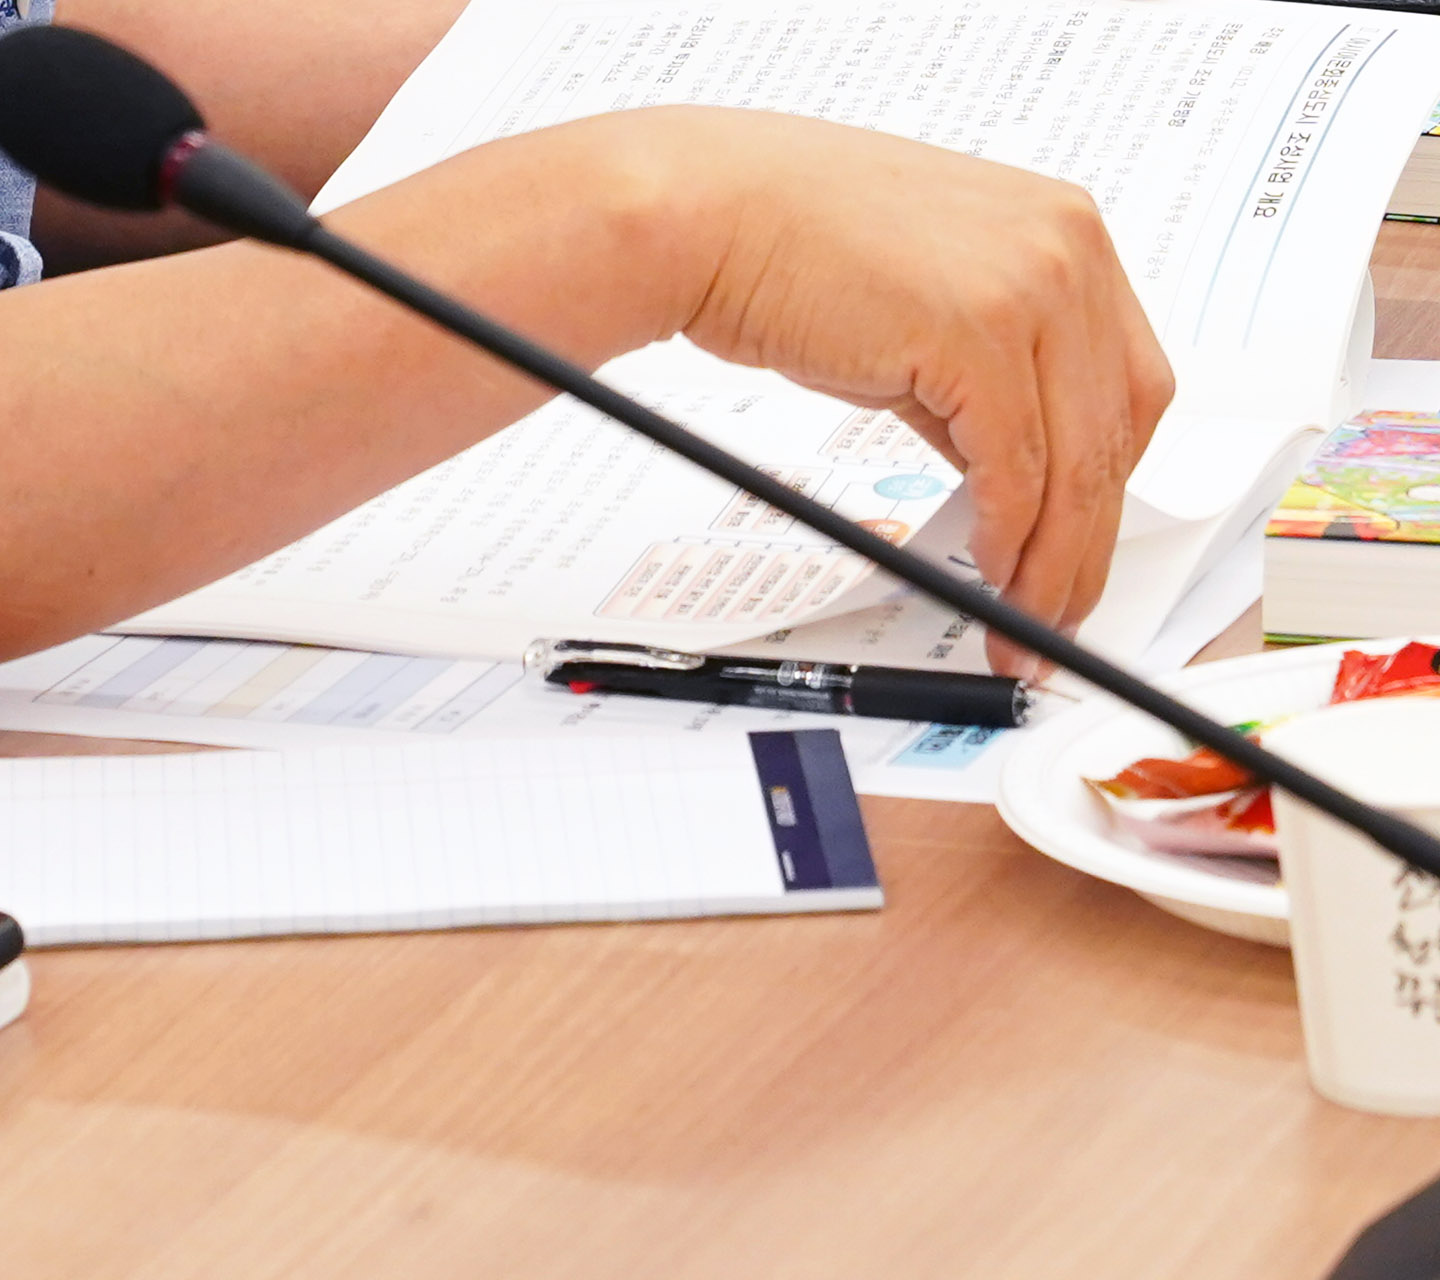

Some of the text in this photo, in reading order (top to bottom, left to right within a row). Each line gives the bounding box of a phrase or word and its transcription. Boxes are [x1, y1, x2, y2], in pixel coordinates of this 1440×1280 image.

[1065, 10, 1089, 27] 주요
[655, 15, 714, 84] 조성사업 투자규모
[1187, 68, 1213, 86] 조성
[1296, 38, 1368, 124] 아시아문화중심도시
[1167, 90, 1201, 127] 기본방향
[1267, 132, 1311, 183] 조성사업
[1252, 191, 1284, 218] 개요
